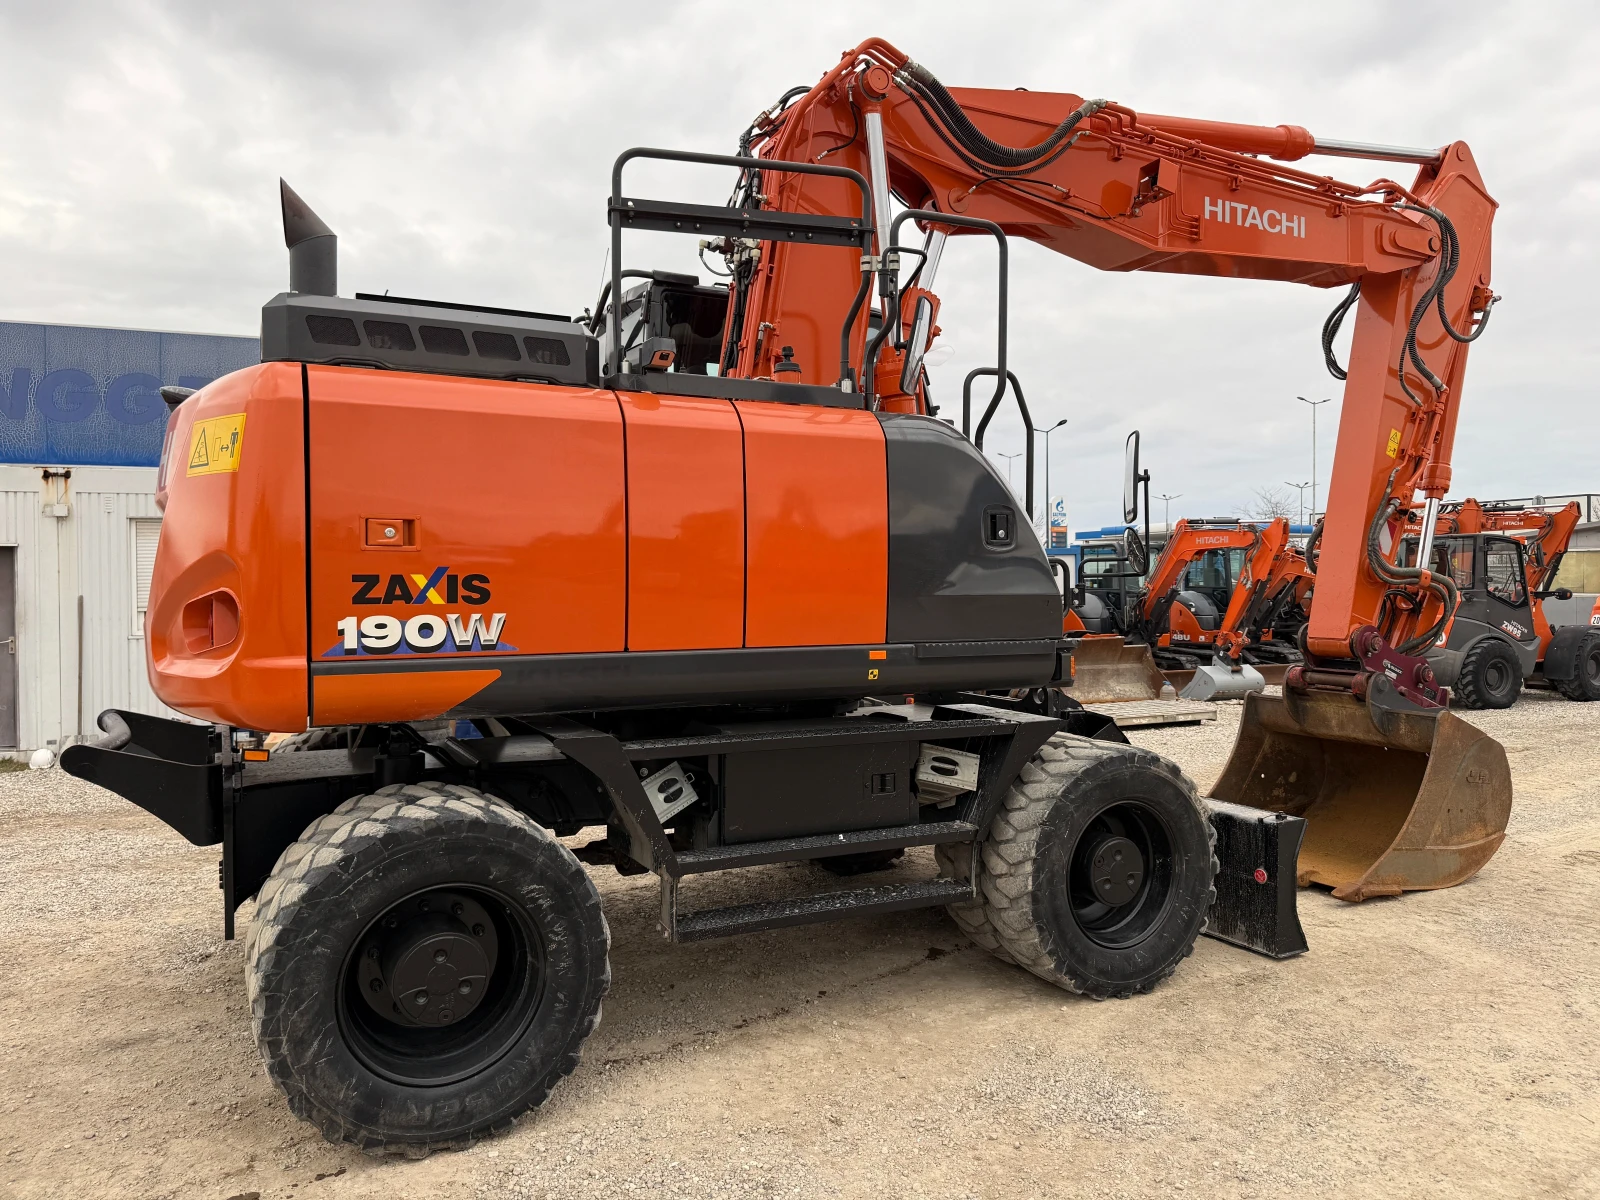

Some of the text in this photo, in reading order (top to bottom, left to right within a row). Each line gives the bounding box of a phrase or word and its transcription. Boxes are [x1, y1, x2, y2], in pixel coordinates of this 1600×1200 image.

[1204, 196, 1306, 239] HITACHI
[1195, 535, 1229, 545] HITACHI
[351, 566, 491, 605] ZAXIS
[337, 612, 507, 654] 190W
[1502, 620, 1522, 637] ZW95
